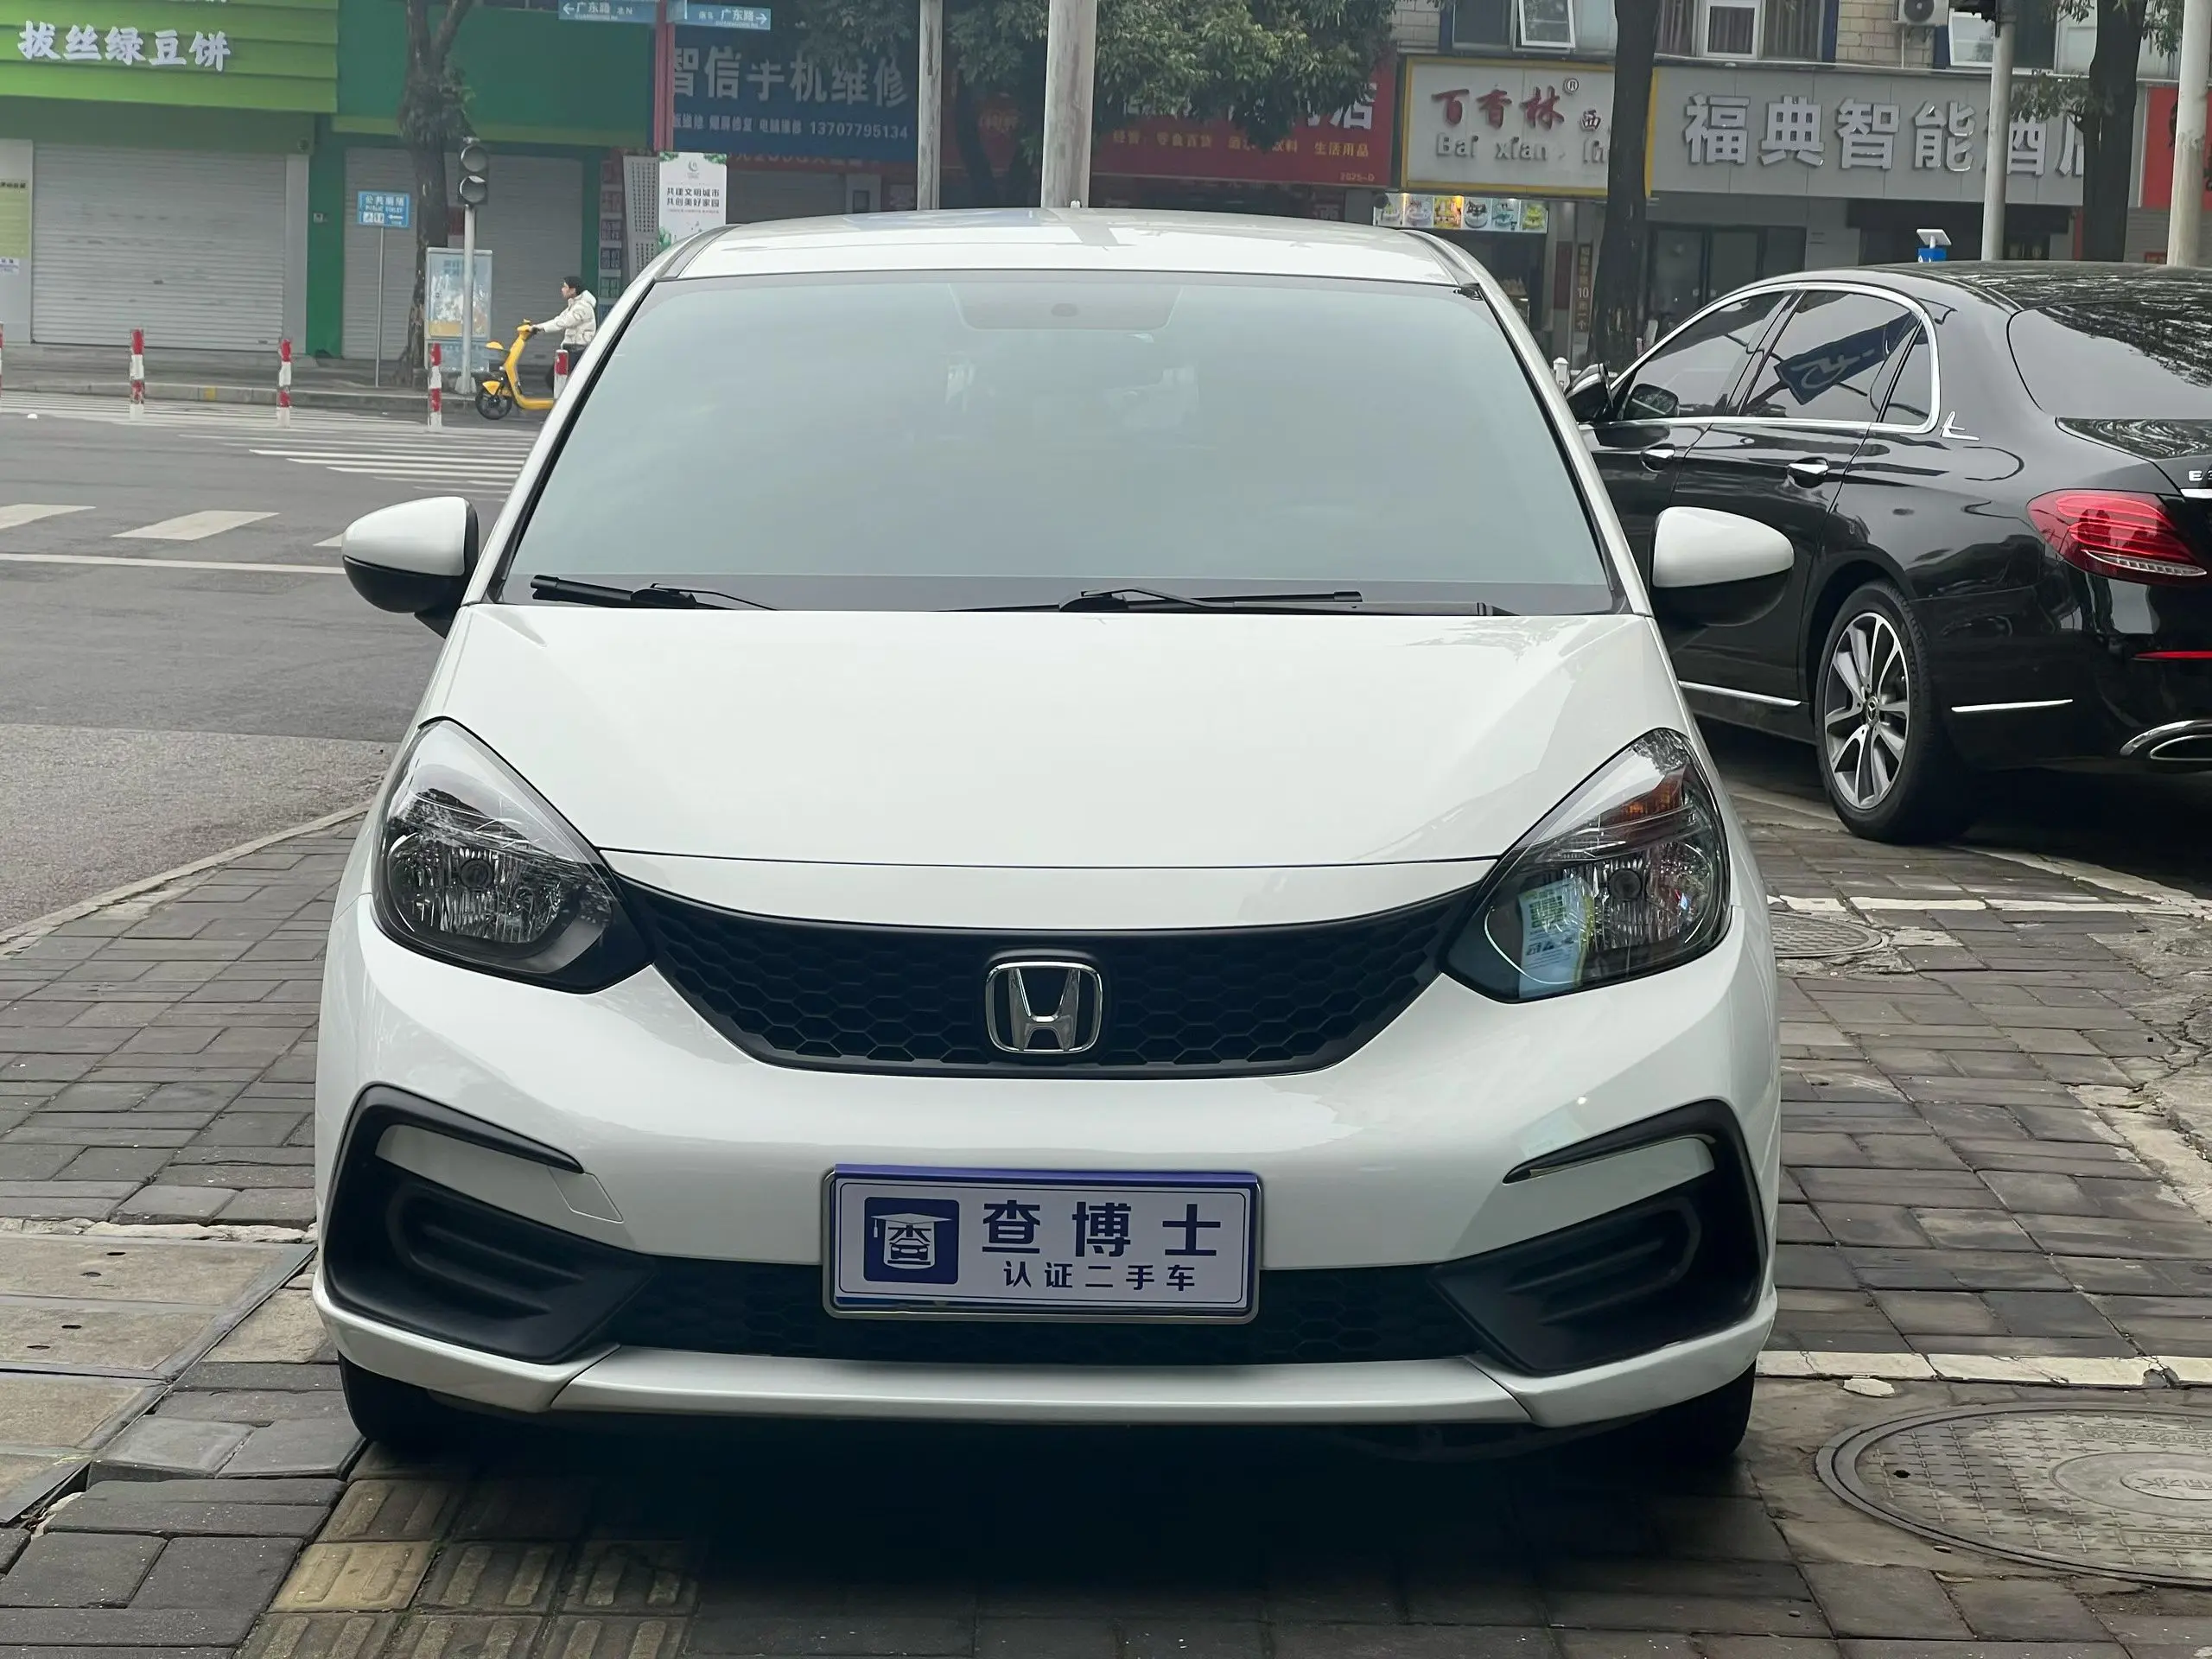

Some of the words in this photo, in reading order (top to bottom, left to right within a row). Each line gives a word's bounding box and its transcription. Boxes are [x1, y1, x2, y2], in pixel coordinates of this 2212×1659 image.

[720, 9, 754, 22] 广东路
[17, 20, 231, 72] 拔丝绿豆饼
[1431, 86, 1565, 129] 百香林
[810, 121, 908, 139] 13707795134
[1314, 140, 1369, 158] 生活用品
[1436, 132, 1478, 158] Bai
[666, 187, 720, 197] 共建文明城市
[666, 198, 720, 207] 共创美好家园
[982, 1199, 1222, 1258] 查博士
[1002, 1261, 1196, 1292] 认证二手车
